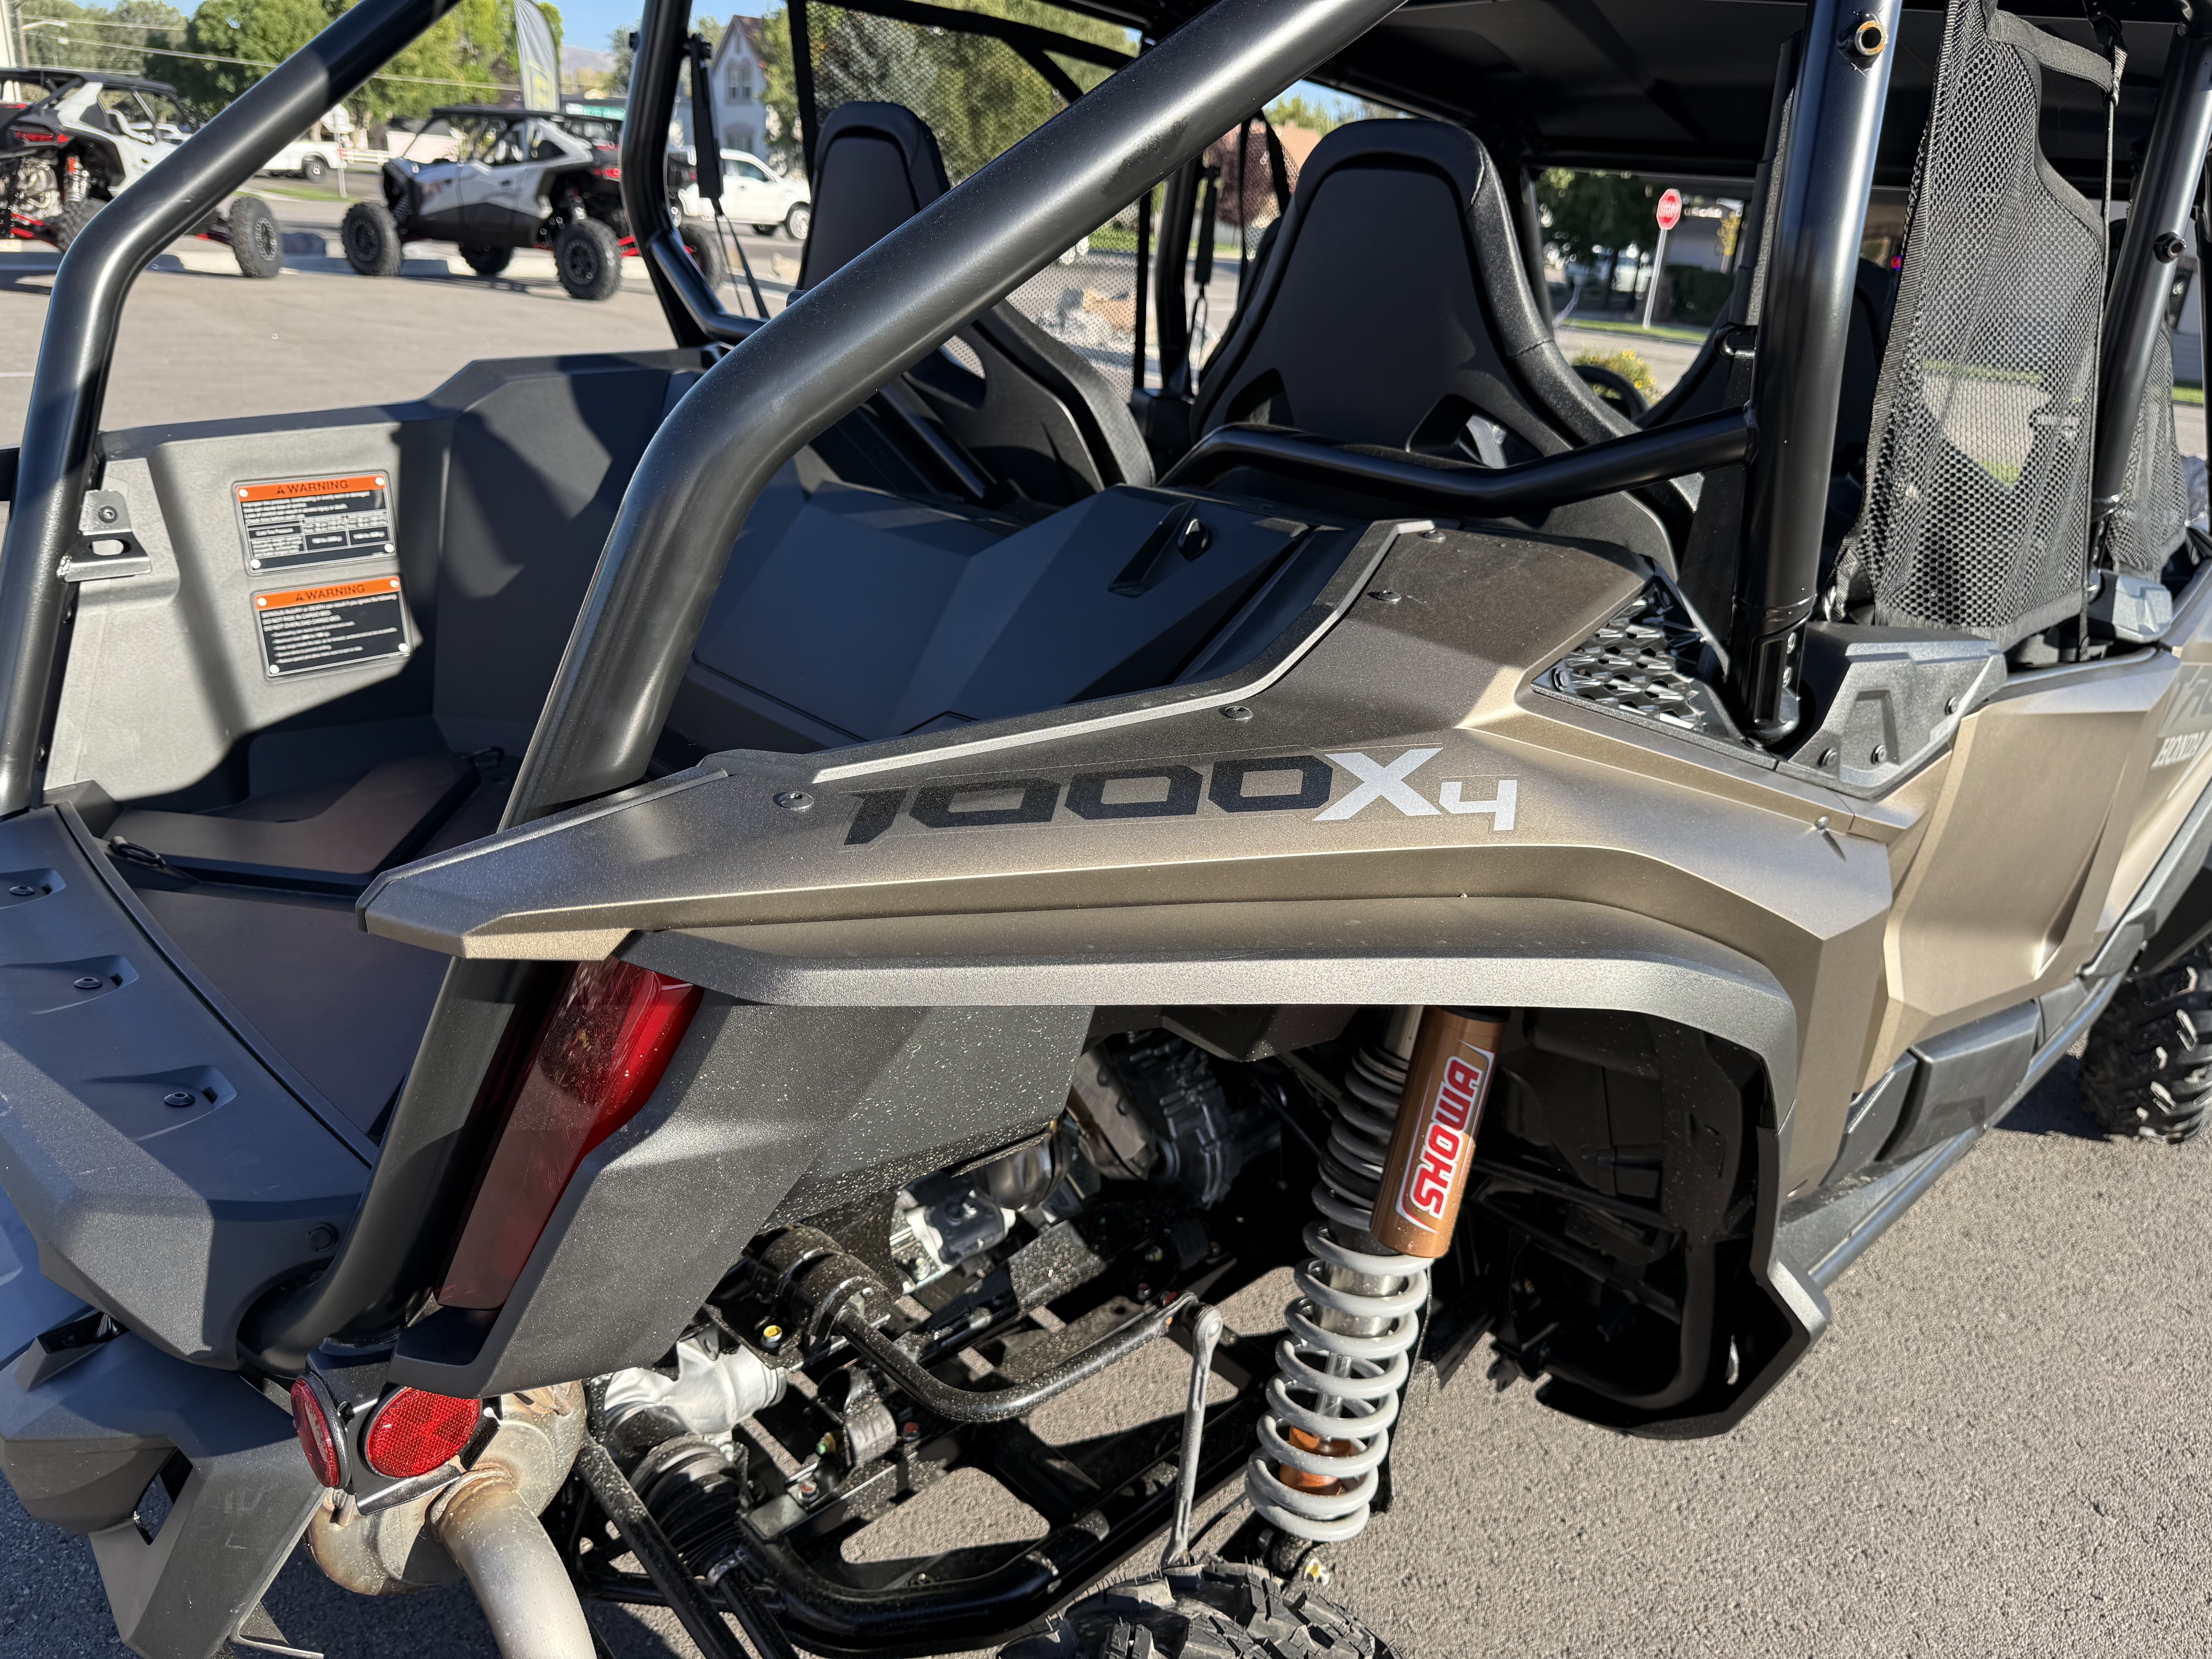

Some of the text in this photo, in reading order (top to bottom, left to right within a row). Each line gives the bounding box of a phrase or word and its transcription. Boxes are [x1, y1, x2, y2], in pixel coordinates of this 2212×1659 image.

[1658, 200, 1680, 218] STOP
[287, 480, 349, 494] WARNING
[307, 584, 366, 600] WARNING
[1410, 1056, 1484, 1219] SHOWA
